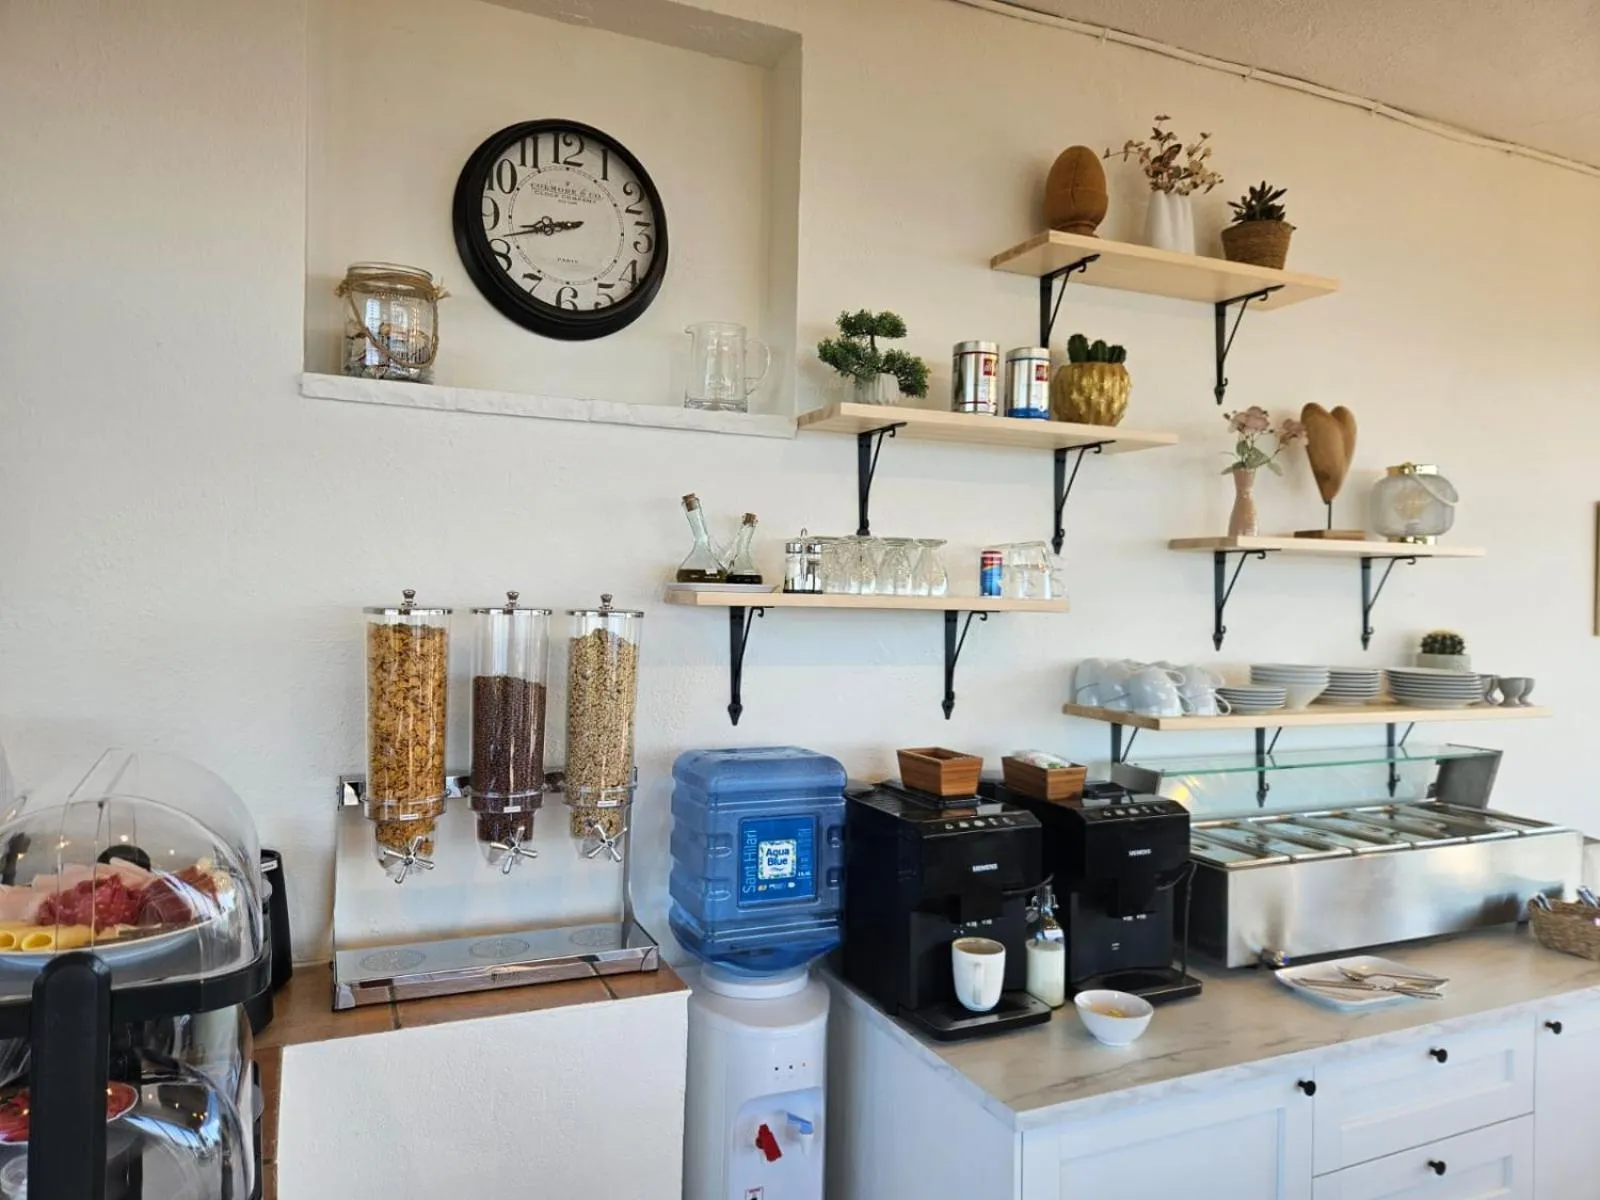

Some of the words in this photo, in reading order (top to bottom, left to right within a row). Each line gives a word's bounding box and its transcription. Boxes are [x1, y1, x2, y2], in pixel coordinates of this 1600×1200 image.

[519, 135, 541, 168] 11
[553, 132, 585, 167] 12
[600, 147, 610, 181] 1
[486, 159, 518, 194] 10
[482, 196, 500, 231] 9
[623, 181, 645, 215] 2
[633, 221, 654, 254] 3
[489, 238, 513, 272] 8
[522, 273, 543, 296] 7
[619, 259, 642, 291] 4
[555, 286, 579, 310] 6
[594, 283, 616, 310] 5
[766, 848, 790, 858] Aqua
[767, 857, 788, 866] Blue
